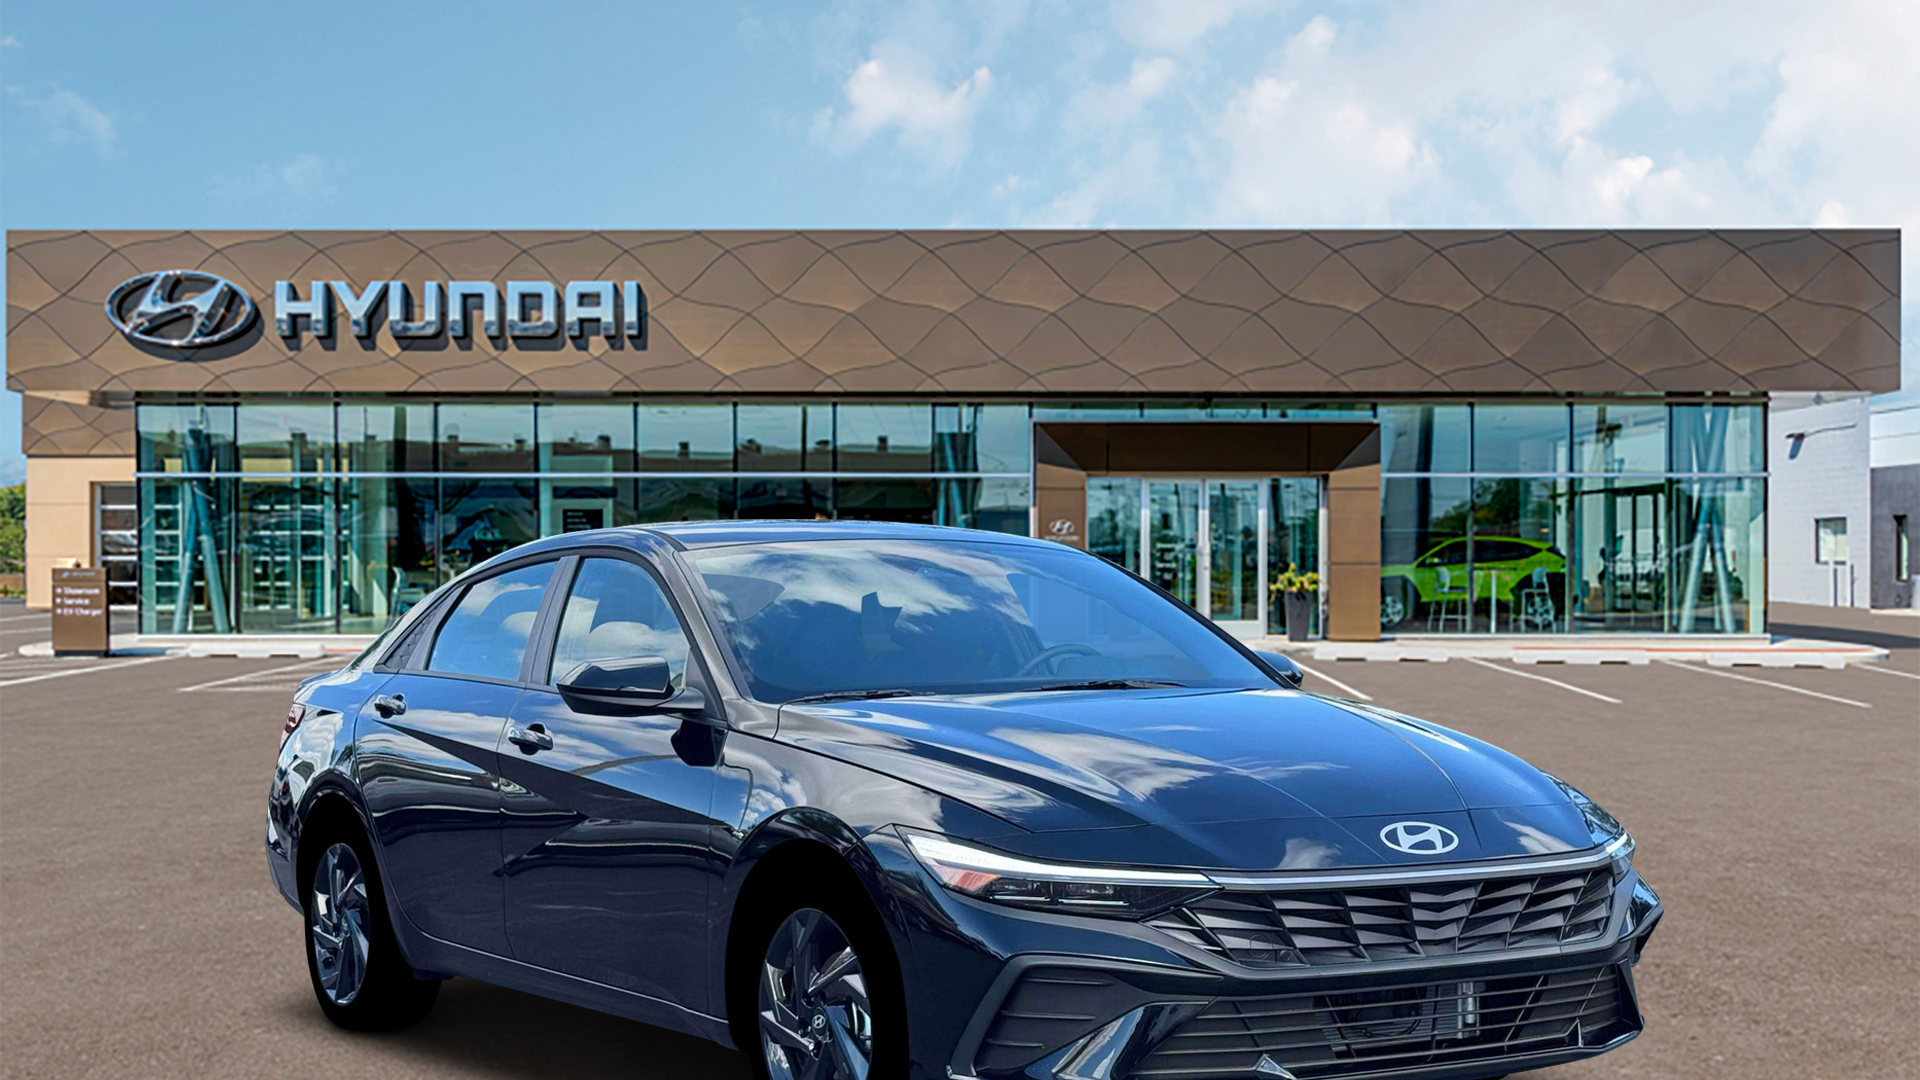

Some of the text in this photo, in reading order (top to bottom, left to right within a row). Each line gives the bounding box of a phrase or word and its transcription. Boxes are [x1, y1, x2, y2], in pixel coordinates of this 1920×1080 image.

[274, 280, 640, 339] HYUNDAI
[63, 587, 100, 595] Showroom
[75, 608, 102, 617] Charger
